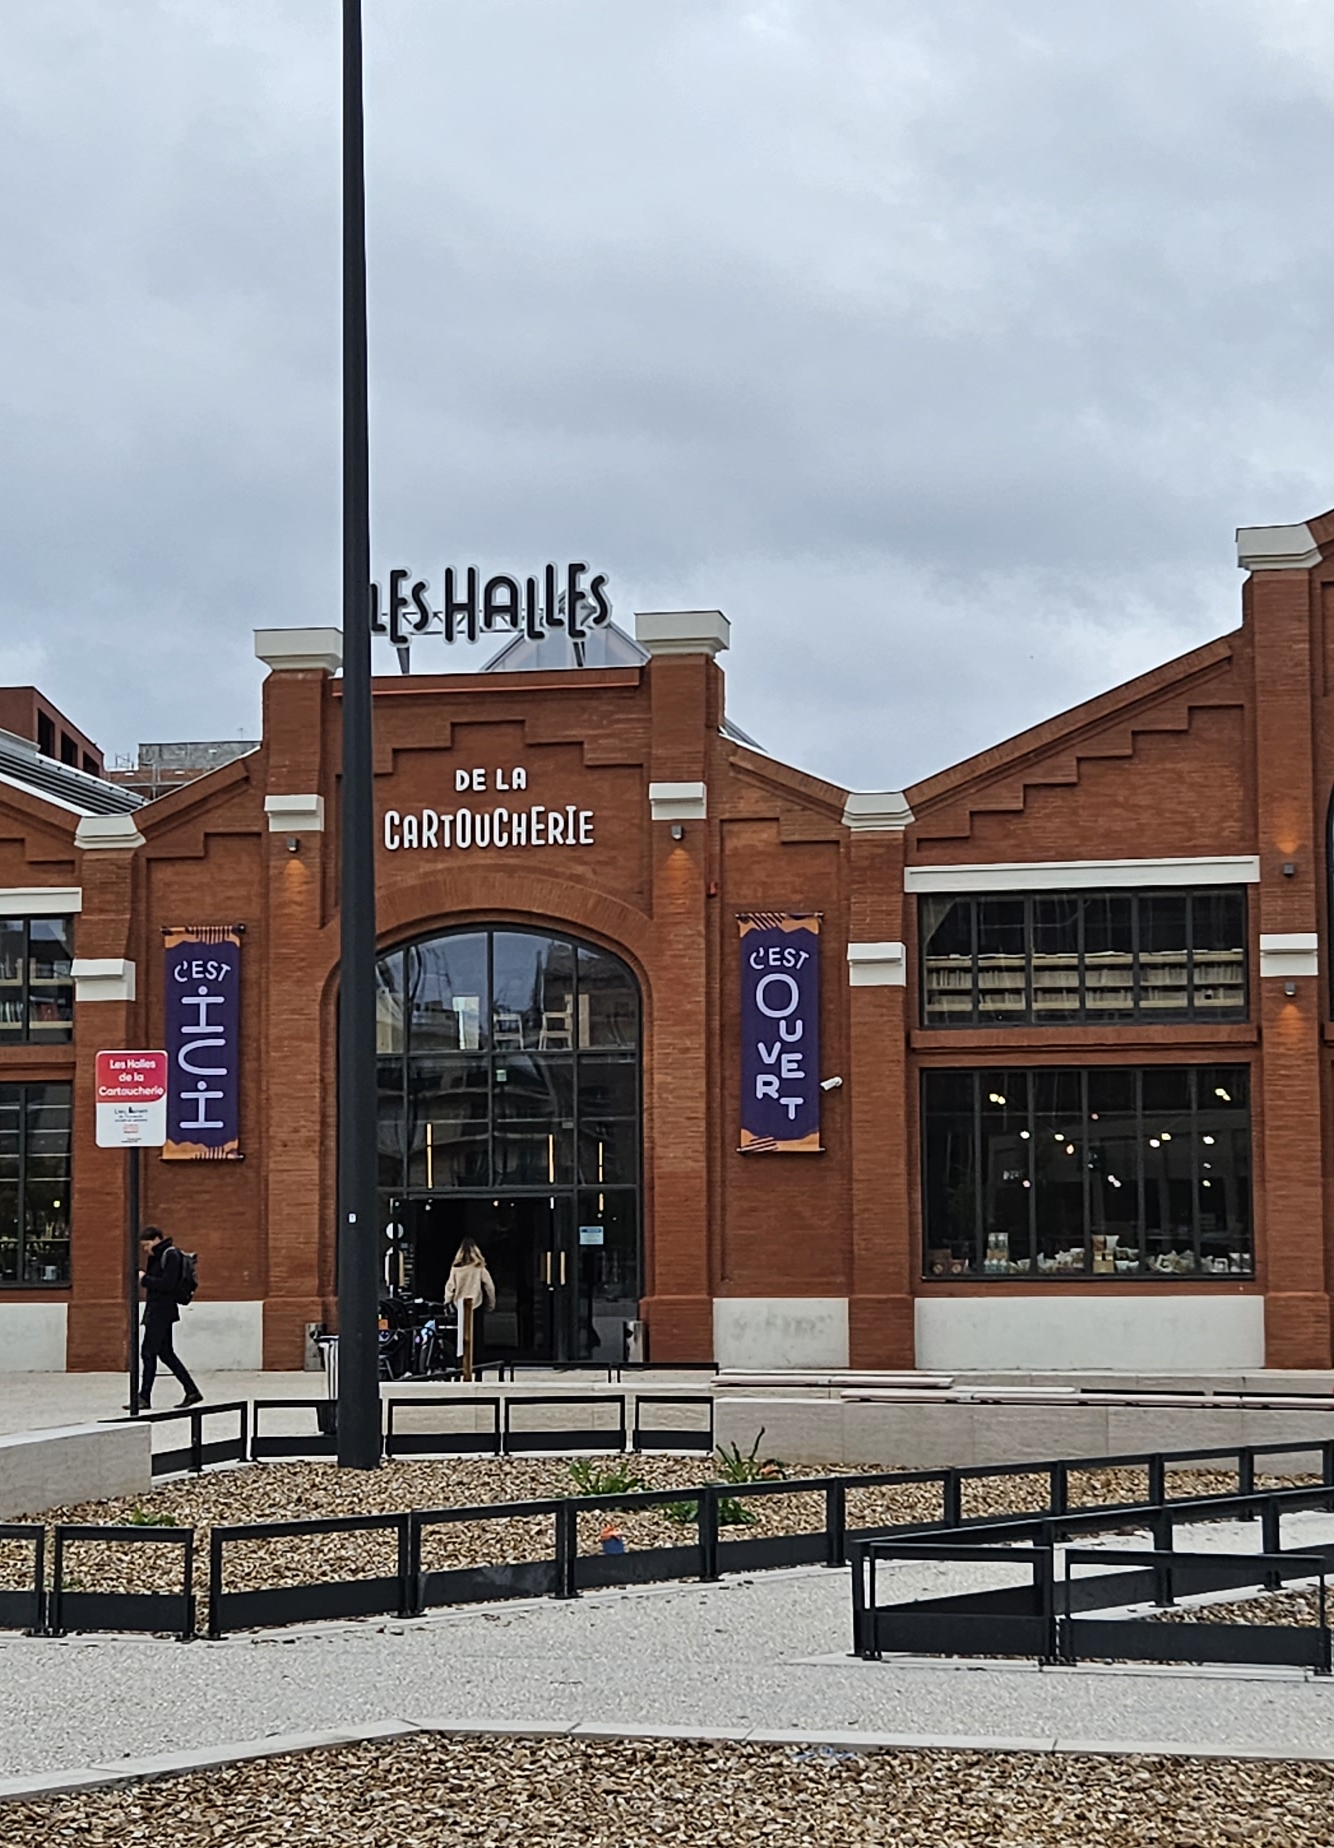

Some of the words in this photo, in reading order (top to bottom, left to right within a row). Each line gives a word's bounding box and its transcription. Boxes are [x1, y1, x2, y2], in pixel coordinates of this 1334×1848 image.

[369, 568, 430, 644] LES
[443, 562, 610, 643] HALLES
[455, 768, 486, 791] DE
[496, 767, 527, 790] LA
[384, 805, 595, 851] CARTOUCHERIE
[749, 947, 810, 970] C'EST
[174, 960, 231, 982] C'EST
[109, 1059, 126, 1070] Les
[127, 1059, 156, 1069] Halles
[118, 1072, 133, 1082] de
[134, 1072, 145, 1082] la
[98, 1085, 165, 1097] Cartoucherie
